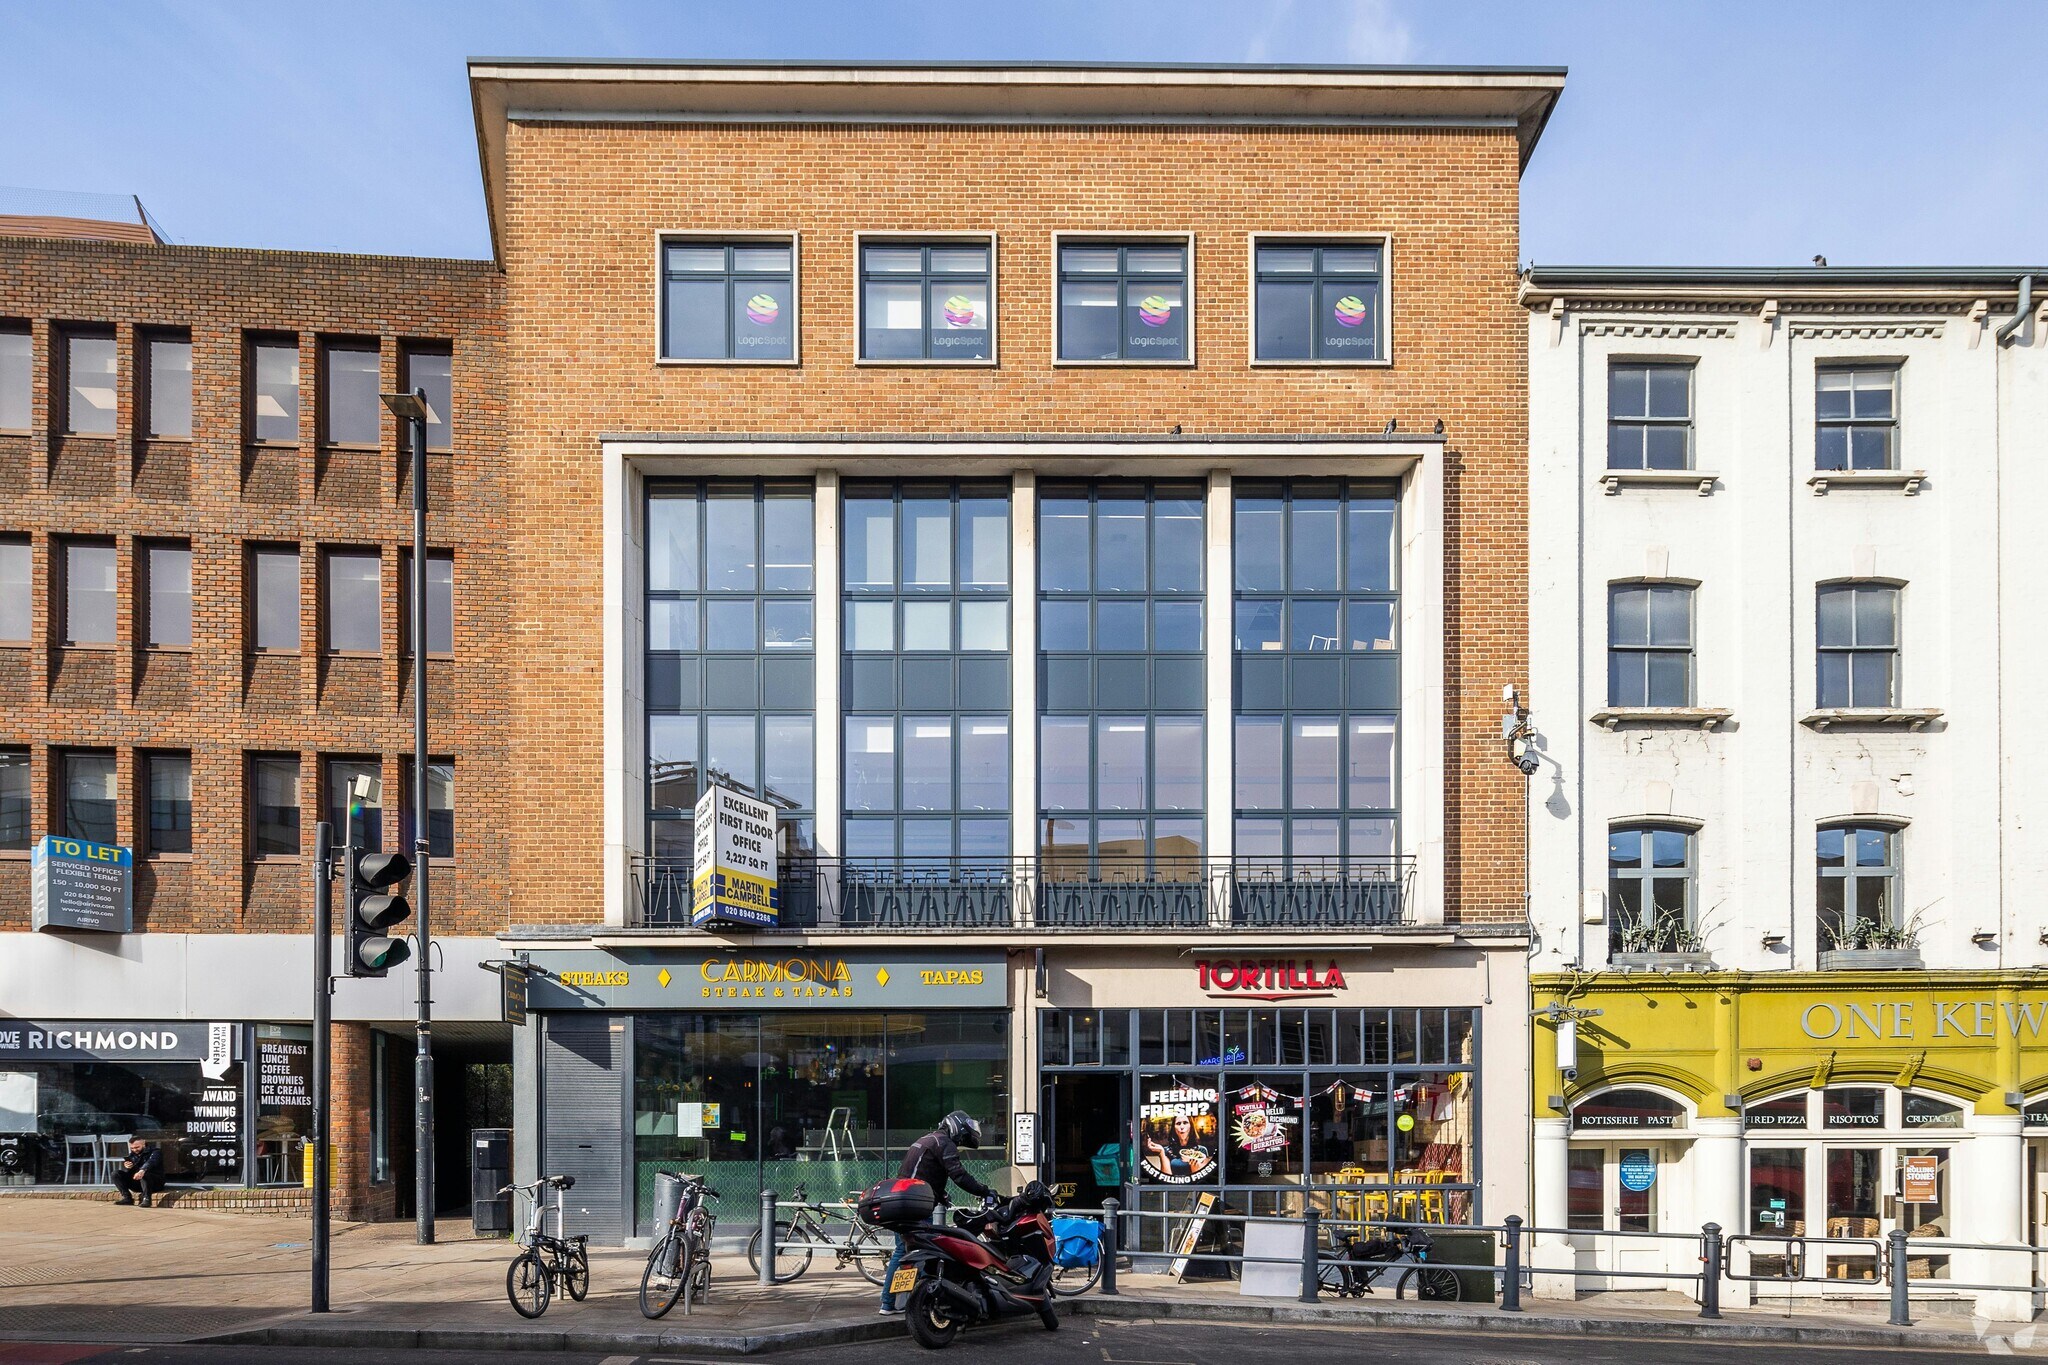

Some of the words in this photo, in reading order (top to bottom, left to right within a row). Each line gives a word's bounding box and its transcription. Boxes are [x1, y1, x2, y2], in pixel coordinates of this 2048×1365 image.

[738, 336, 787, 346] LogicSpot
[934, 336, 983, 346] LogicSpot
[1130, 336, 1179, 347] LogicSpot
[1326, 336, 1374, 347] LogicSpot
[724, 796, 768, 822] EXCELLENT
[720, 812, 742, 830] FIRST
[746, 820, 773, 840] FLOOR
[732, 834, 762, 853] OFFICE
[51, 840, 80, 856] TO
[87, 845, 122, 862] LET
[726, 850, 746, 864] 2,227
[748, 857, 759, 870] SQ
[761, 861, 768, 871] FT
[51, 860, 90, 871] SERVICED
[92, 866, 122, 876] OFFICES
[56, 868, 91, 878] FLEXIBLE
[93, 873, 118, 882] TERMS
[75, 881, 99, 890] 10,000
[732, 878, 764, 895] MARTIN
[726, 888, 769, 907] CAMPBELL
[60, 898, 115, 910] hello@airivo.com
[62, 906, 114, 917] www.airivo.com
[725, 906, 737, 915] 020
[740, 908, 755, 919] 8940
[701, 958, 852, 983] CARMONA
[1195, 959, 1346, 989] TORTILLA
[560, 971, 629, 986] STEAKS
[920, 970, 984, 985] TAPAS
[702, 987, 765, 998] STEAK
[774, 987, 784, 998] &
[793, 987, 853, 998] TAPAS
[1801, 1000, 1914, 1040] ONE
[1932, 1000, 2048, 1040] KEW
[0, 1031, 20, 1043] OVE
[28, 1031, 178, 1050] RICHMOND
[261, 1044, 307, 1055] BREAKFAST
[261, 1054, 289, 1064] LUNCH
[261, 1064, 290, 1075] COFFEE
[261, 1075, 304, 1085] BROWNIES
[202, 1090, 236, 1102] AWARD
[261, 1085, 274, 1094] ICE
[277, 1086, 304, 1096] CREAM
[1150, 1088, 1216, 1103] FEELING
[261, 1096, 312, 1106] MILKSHAKES
[194, 1106, 236, 1117] WINNING
[1140, 1102, 1210, 1119] FRESH?
[1581, 1116, 1639, 1125] ROTISSERIE
[1648, 1116, 1678, 1124] PASTA
[1777, 1116, 1806, 1124] PIZZA
[1829, 1115, 1878, 1124] RISOTTOS
[1906, 1115, 1955, 1123] CRUSTACEA
[187, 1122, 236, 1133] BROWNIES
[1253, 1138, 1282, 1149] BURRITOS
[1140, 1160, 1160, 1178] FAST
[1159, 1175, 1191, 1184] FILLING
[1191, 1160, 1217, 1182] FRESH
[894, 1271, 915, 1281] RK20
[894, 1280, 911, 1290] BPF
